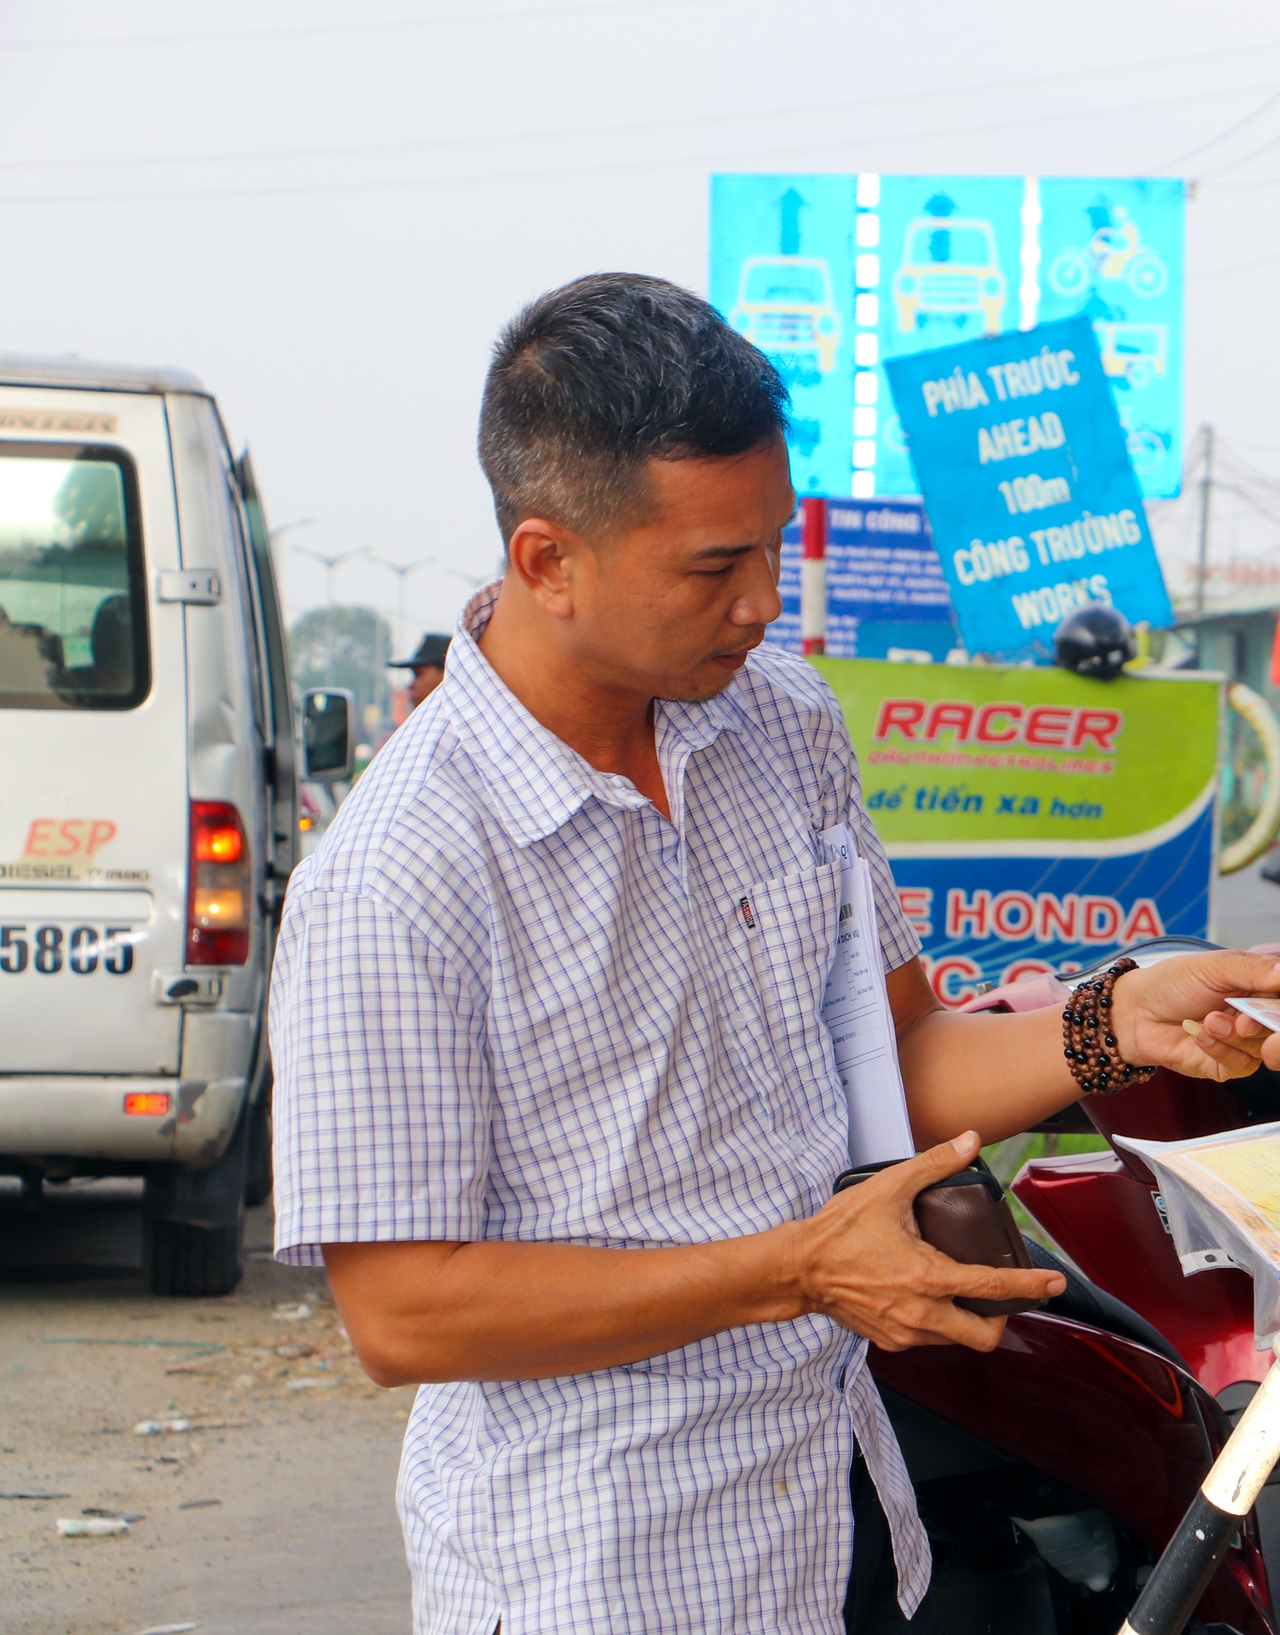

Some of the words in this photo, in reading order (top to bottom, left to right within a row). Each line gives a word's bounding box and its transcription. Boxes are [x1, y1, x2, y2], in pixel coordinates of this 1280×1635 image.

[922, 365, 990, 418] PHÍA
[978, 410, 1067, 465] AHEAD
[998, 473, 1072, 516] 100m
[953, 538, 1031, 587] CÔNG
[873, 698, 1124, 754] RACER
[867, 784, 908, 811] để
[913, 784, 984, 814] tiến
[995, 794, 1041, 816] xa
[24, 818, 117, 857] ESP
[946, 887, 1166, 946] HONDA
[0, 925, 134, 974] 5805
